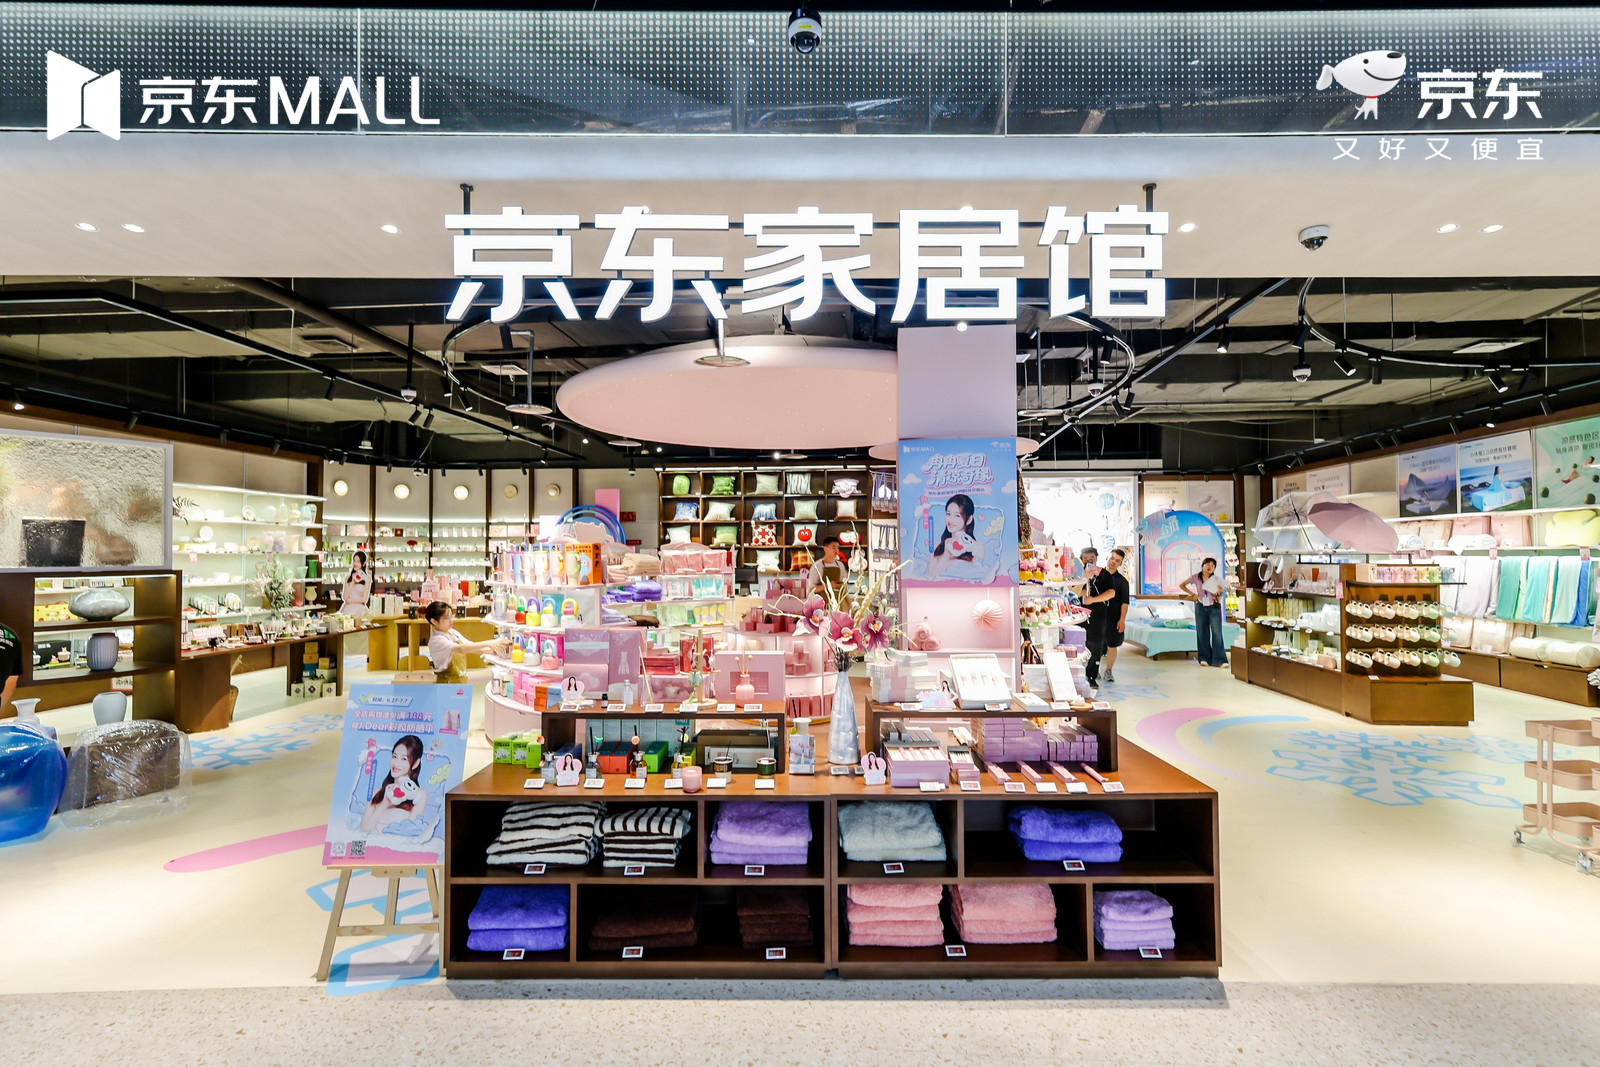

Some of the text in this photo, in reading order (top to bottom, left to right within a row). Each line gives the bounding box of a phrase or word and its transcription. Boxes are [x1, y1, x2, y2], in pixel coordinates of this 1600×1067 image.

[444, 204, 1169, 324] 京东家居馆
